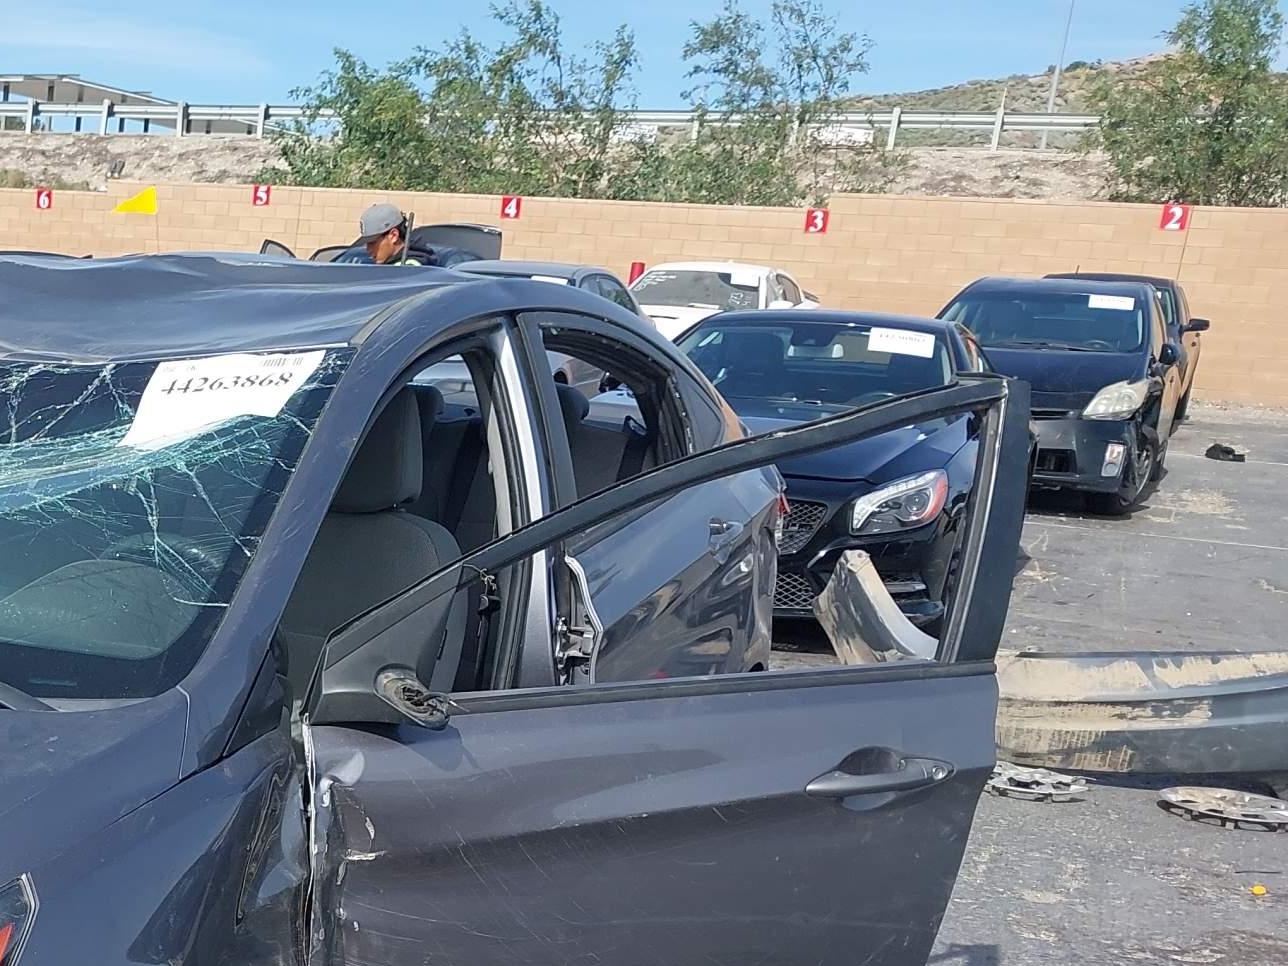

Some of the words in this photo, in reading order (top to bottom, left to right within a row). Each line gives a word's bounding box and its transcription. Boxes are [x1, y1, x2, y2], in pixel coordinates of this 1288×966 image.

[40, 192, 50, 208] 6
[255, 187, 265, 205] 5
[505, 198, 517, 218] 4
[1165, 206, 1183, 230] 2
[809, 211, 824, 232] 3
[161, 372, 293, 395] 44263868
